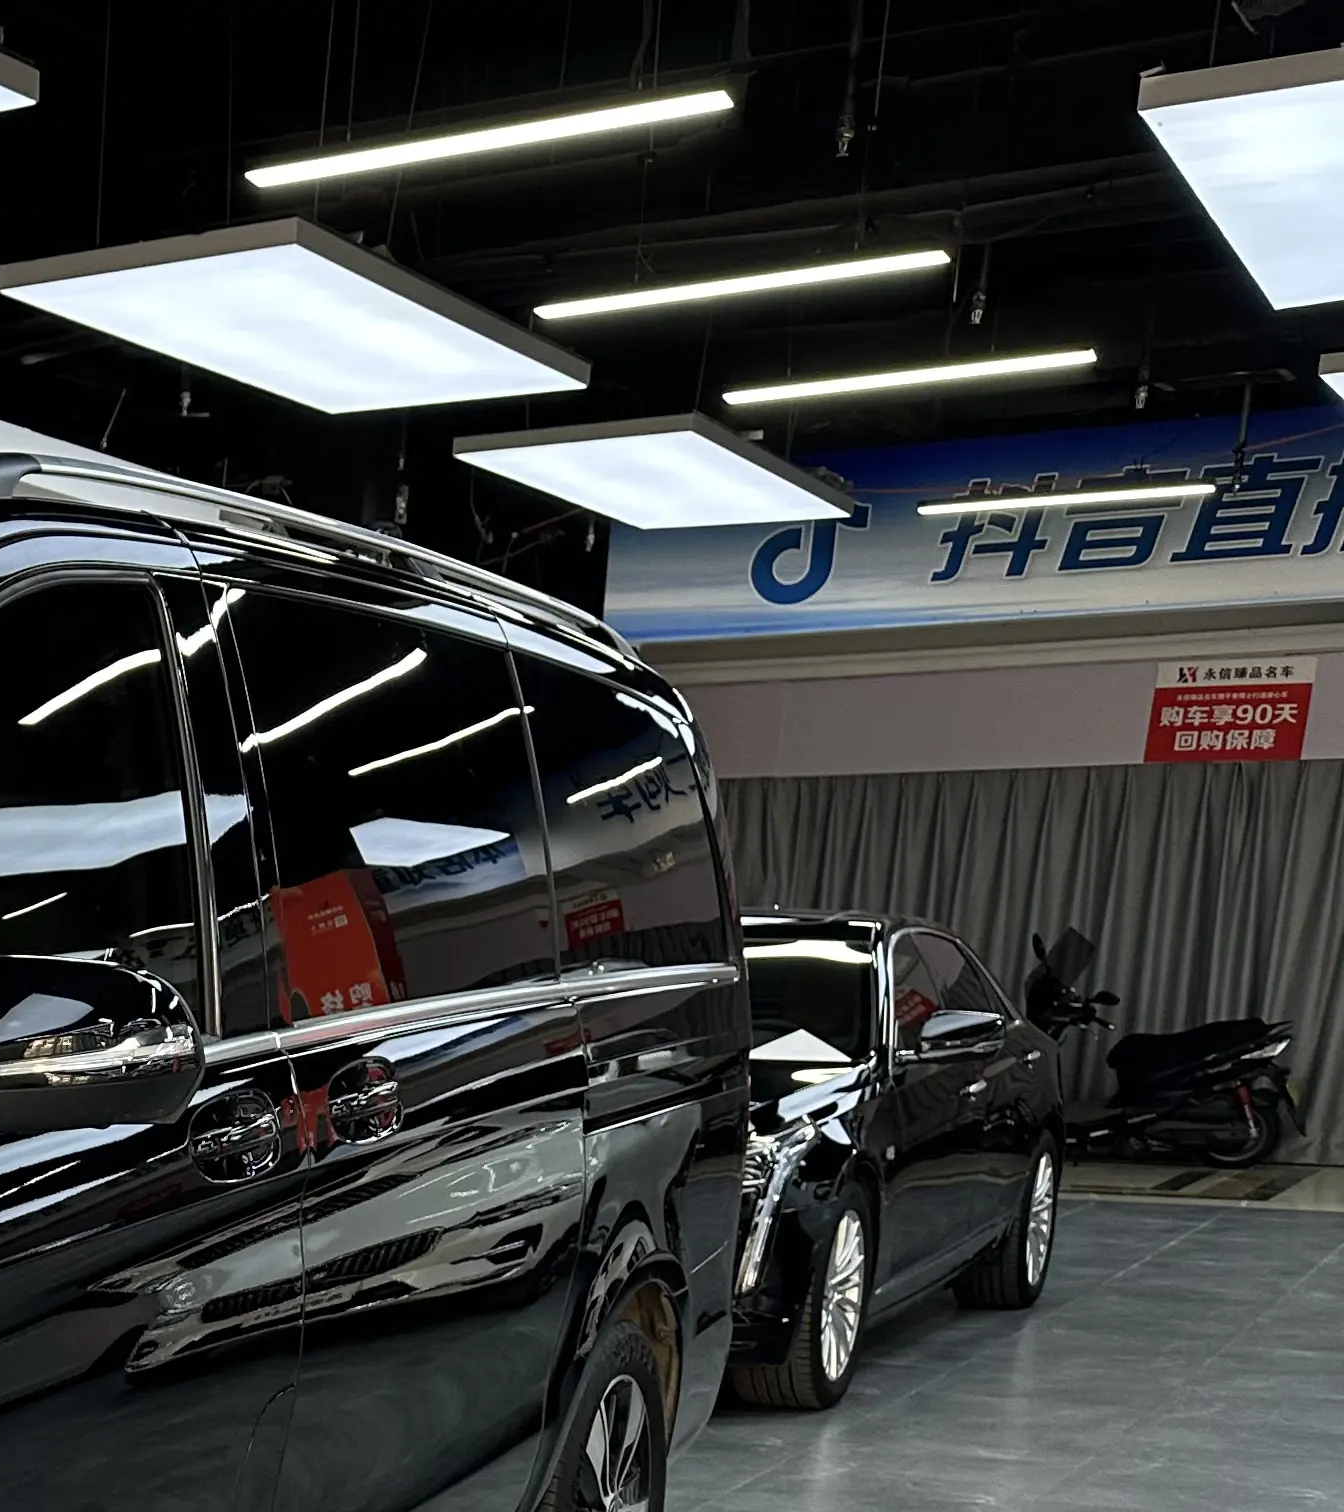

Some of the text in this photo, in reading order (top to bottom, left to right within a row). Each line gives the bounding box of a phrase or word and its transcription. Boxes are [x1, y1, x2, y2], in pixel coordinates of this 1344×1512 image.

[1159, 703, 1298, 727] 购车享90天
[1173, 729, 1276, 751] 回购保障
